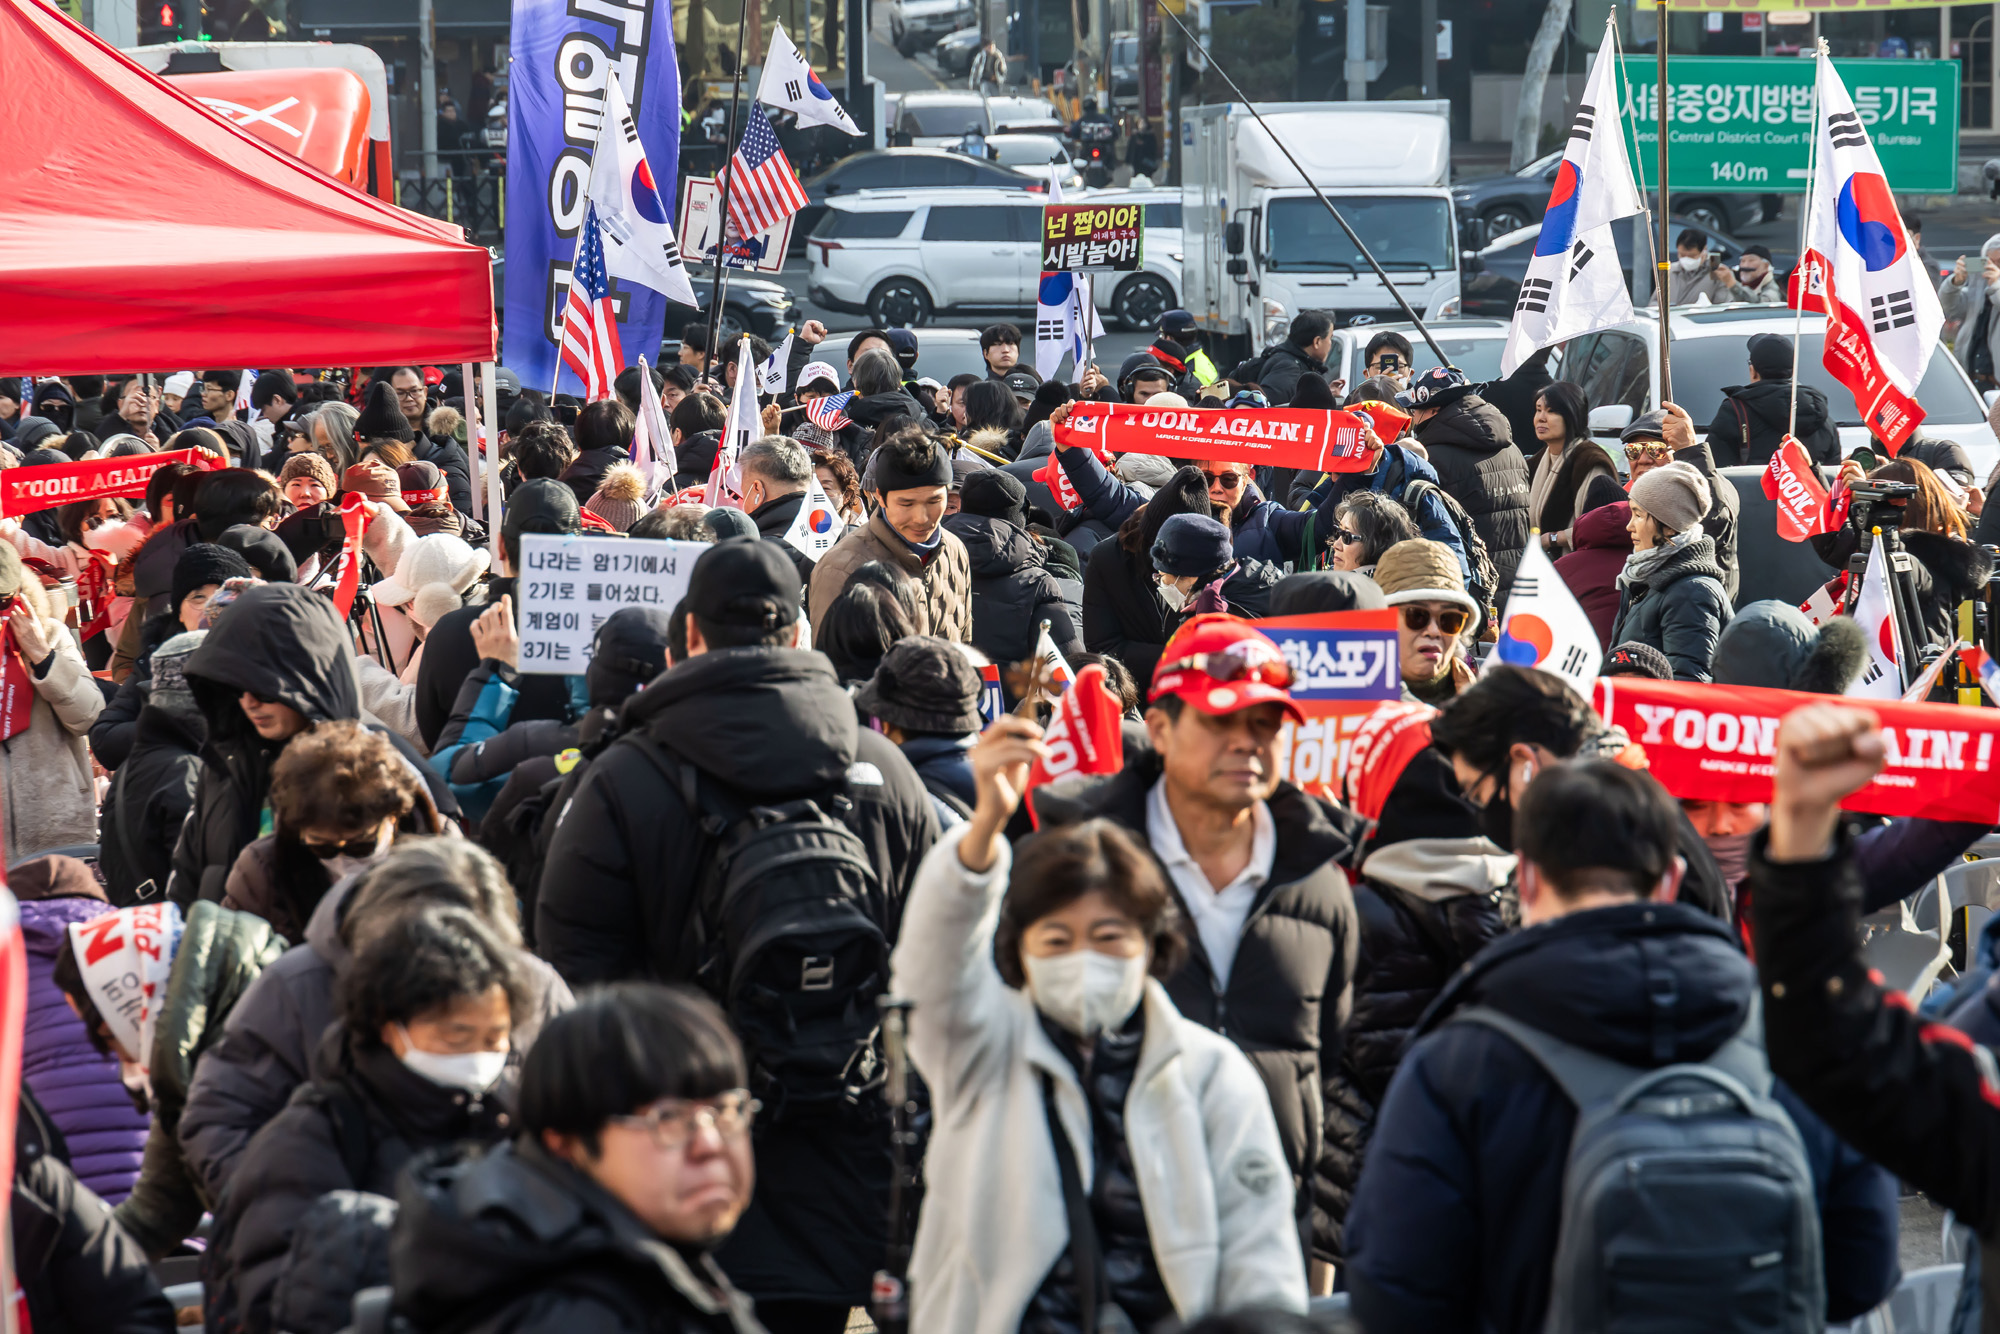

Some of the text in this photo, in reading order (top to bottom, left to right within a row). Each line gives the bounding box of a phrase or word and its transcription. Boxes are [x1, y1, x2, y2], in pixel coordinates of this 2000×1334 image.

[1856, 86, 1938, 125] 등기국
[1669, 130, 1714, 143] Central
[1717, 130, 1761, 144] District
[1764, 131, 1798, 144] Court
[1878, 133, 1921, 145] Bureau
[1710, 161, 1769, 181] 140m
[1047, 205, 1138, 239] 넌 짭이야
[731, 257, 758, 268] AGAIN
[1043, 238, 1138, 269] 시발놈아!
[1209, 419, 1299, 443] AGAIN
[1886, 414, 1910, 441] AGAIN
[1155, 433, 1272, 450] MAKE KOREA GREAT AGAIN
[528, 552, 677, 575] 나라는 암1기에서
[529, 582, 575, 600] 2기로
[526, 612, 579, 630] 계엄이
[523, 642, 571, 660] 3기는
[1882, 727, 1969, 770] AIN
